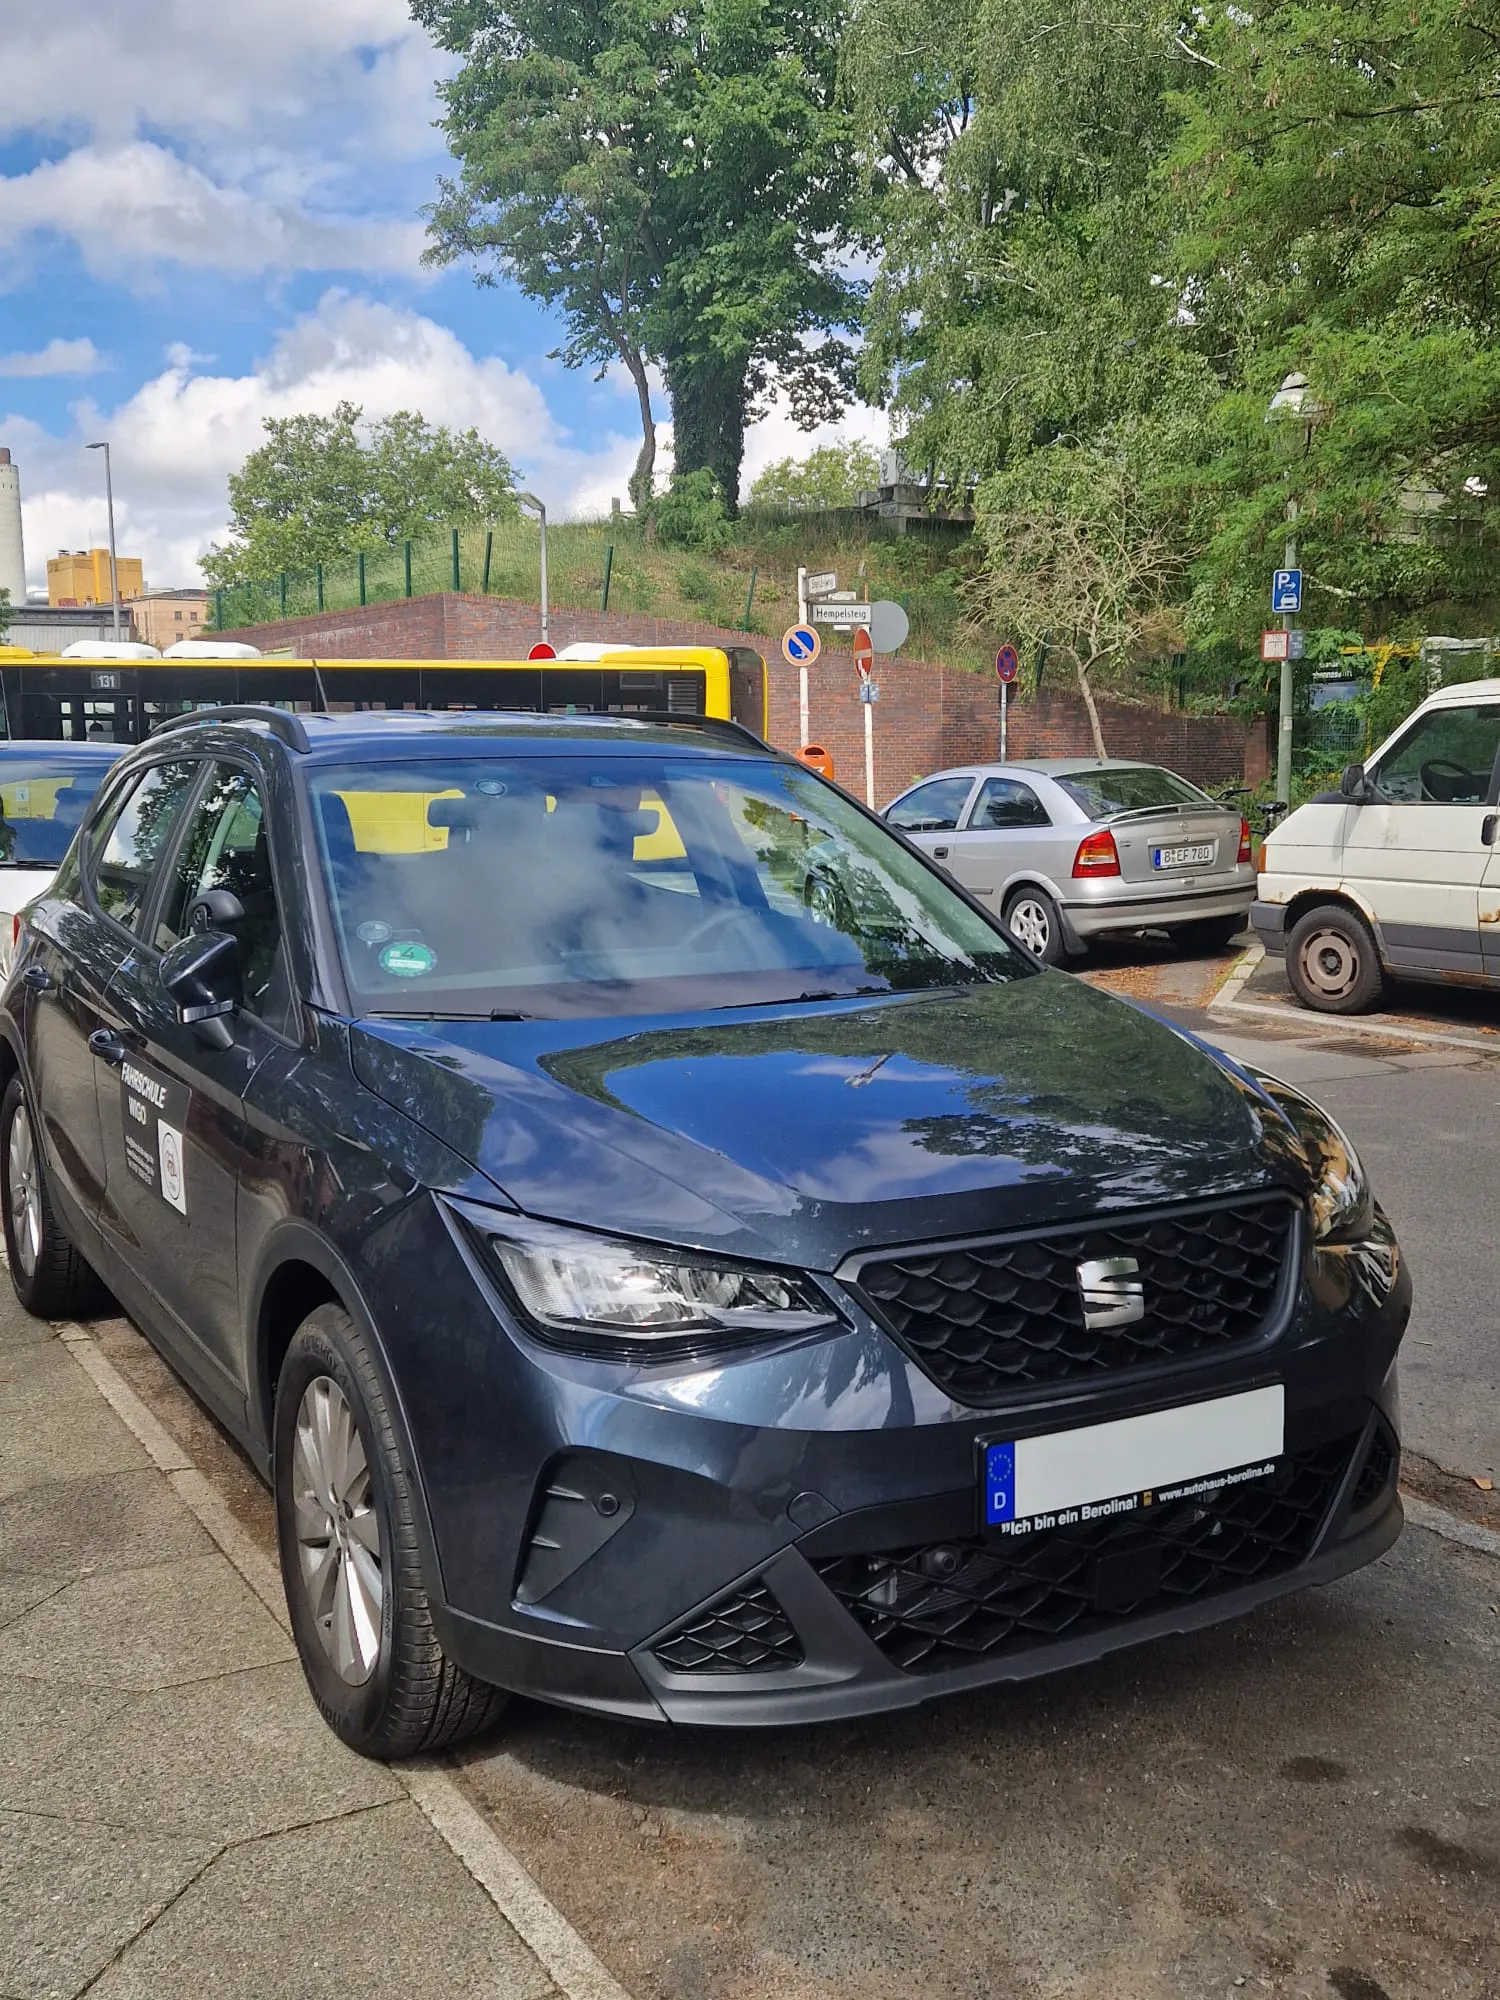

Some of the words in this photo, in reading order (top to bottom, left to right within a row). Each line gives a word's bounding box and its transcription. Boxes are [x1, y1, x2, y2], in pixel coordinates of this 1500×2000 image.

[1278, 573, 1290, 590] P
[816, 608, 867, 620] Hempelsteig
[98, 675, 115, 688] 131
[1164, 851, 1171, 863] B
[1177, 849, 1189, 862] EF
[121, 1062, 167, 1109] FAHRSCHULE
[1158, 1463, 1275, 1502] www.autohaus-berolina.de
[994, 1491, 1006, 1510] D
[1034, 1515, 1055, 1531] bin
[1058, 1509, 1078, 1525] ein
[1081, 1494, 1138, 1521] Berolina!
